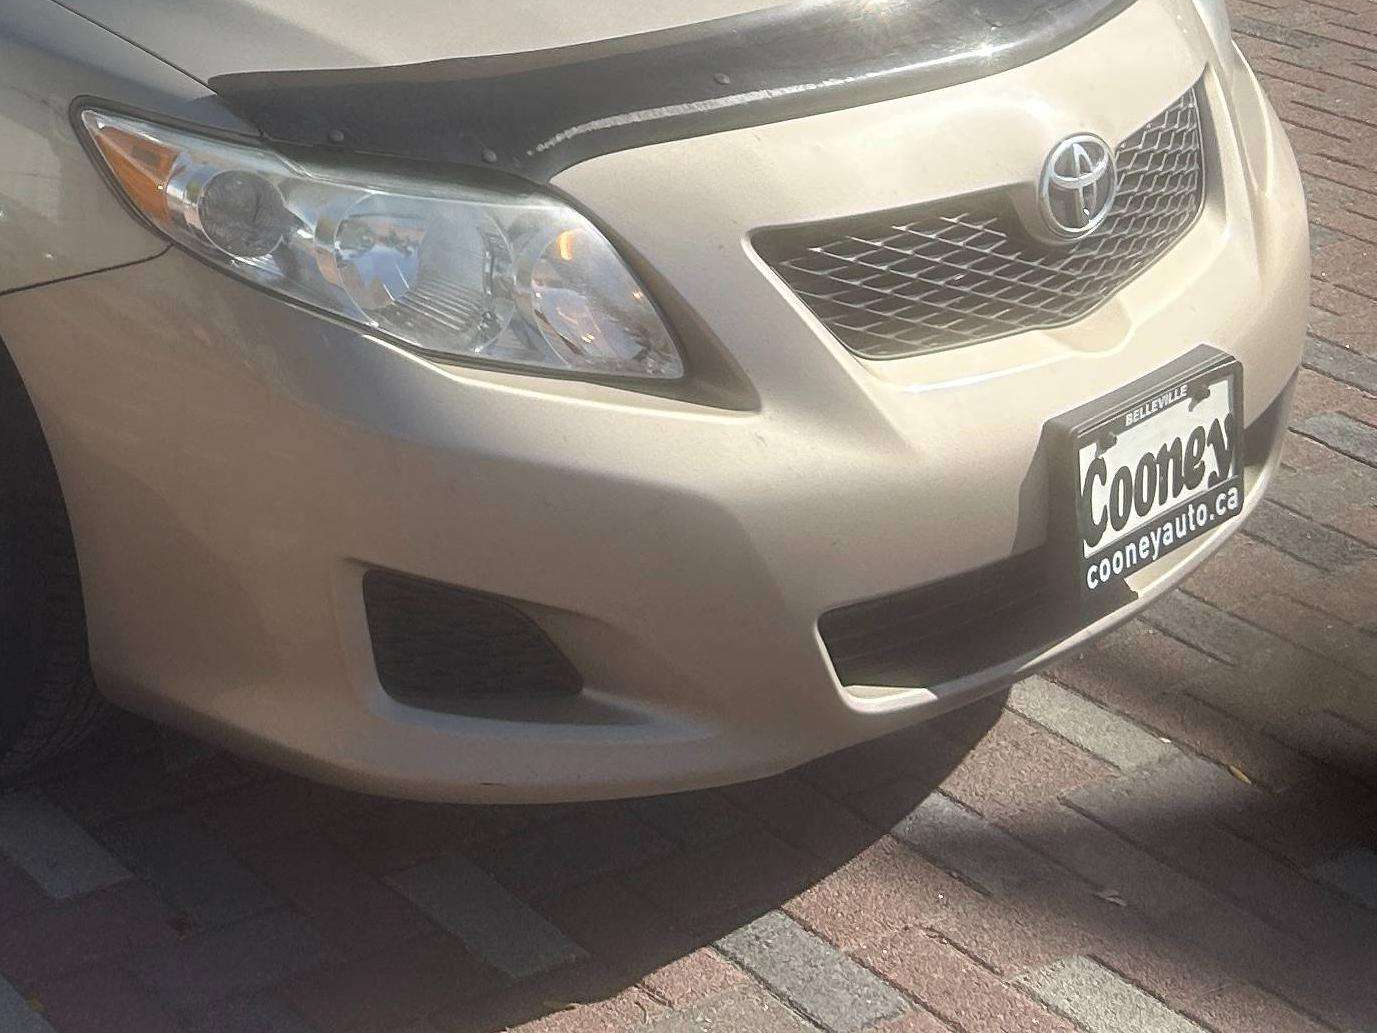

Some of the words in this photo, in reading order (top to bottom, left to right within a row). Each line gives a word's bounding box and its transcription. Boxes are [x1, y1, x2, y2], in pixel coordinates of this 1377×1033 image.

[1125, 384, 1188, 427] BELLEVILLE
[1080, 412, 1234, 548] Cooney
[1086, 486, 1240, 590] cooneyauto.ca
